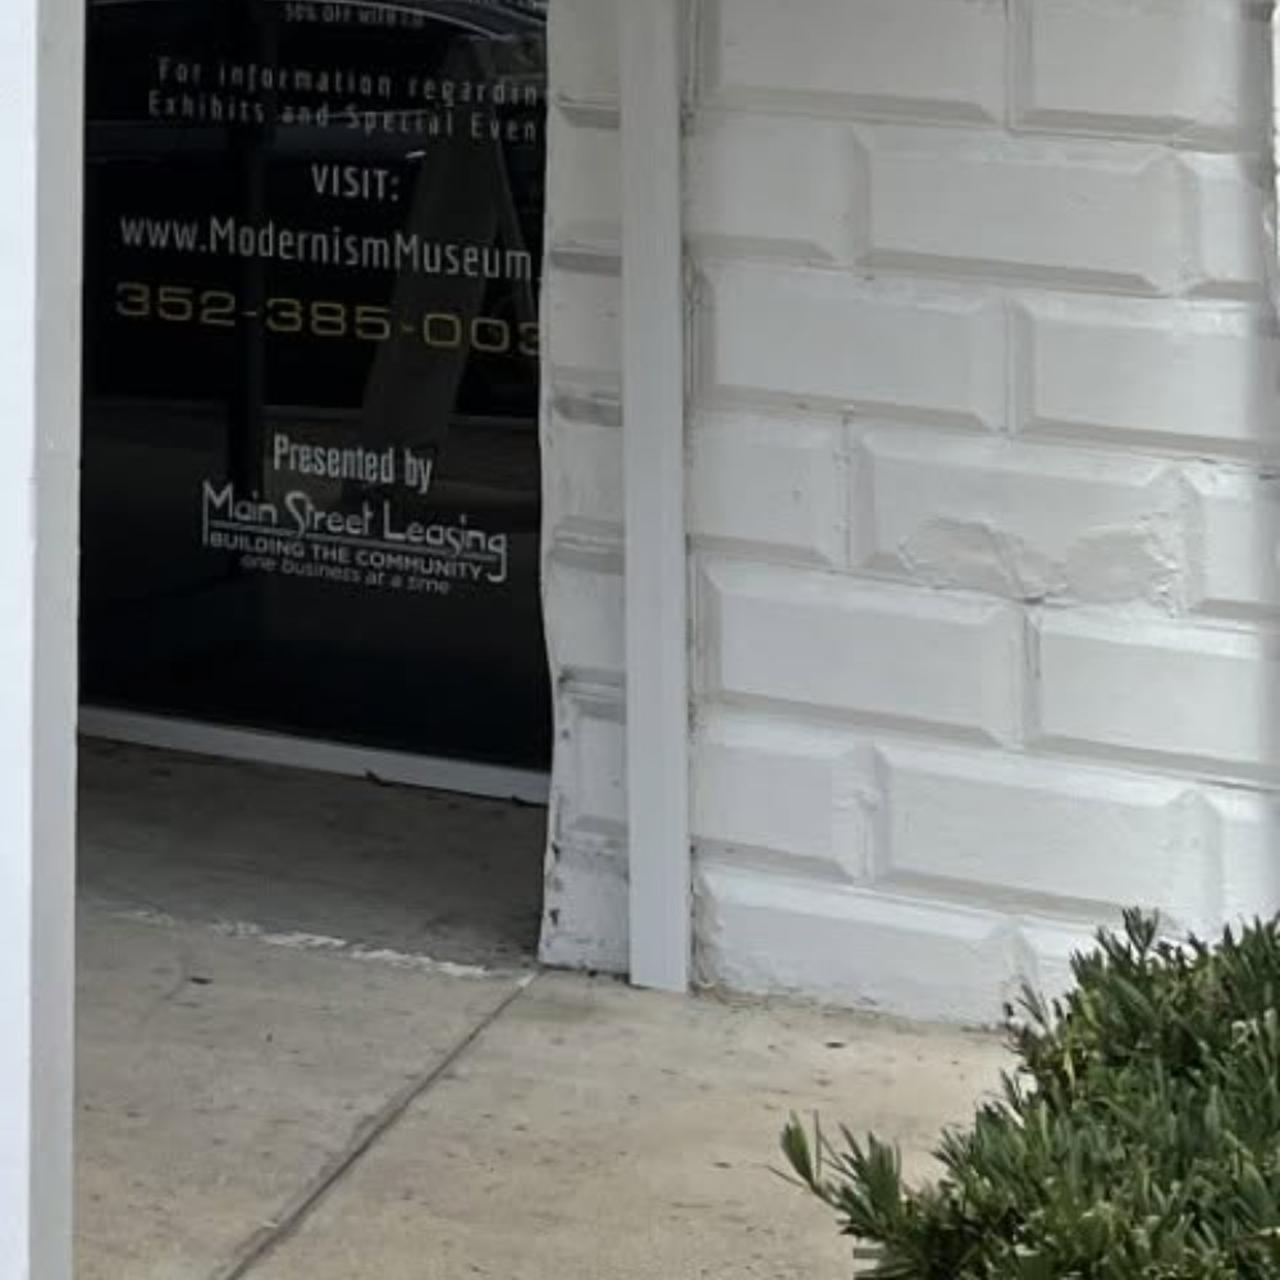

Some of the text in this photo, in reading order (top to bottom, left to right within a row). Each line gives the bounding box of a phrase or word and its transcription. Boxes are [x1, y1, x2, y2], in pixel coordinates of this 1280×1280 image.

[218, 61, 391, 98] information
[147, 88, 265, 124] Exhibits
[345, 102, 453, 138] Special
[310, 162, 400, 202] VISIT:
[272, 433, 434, 494] Presented by
[202, 479, 508, 583] Main Street Leasing
[209, 531, 484, 581] BUILDING THE COMMUNITY
[281, 556, 361, 583] business
